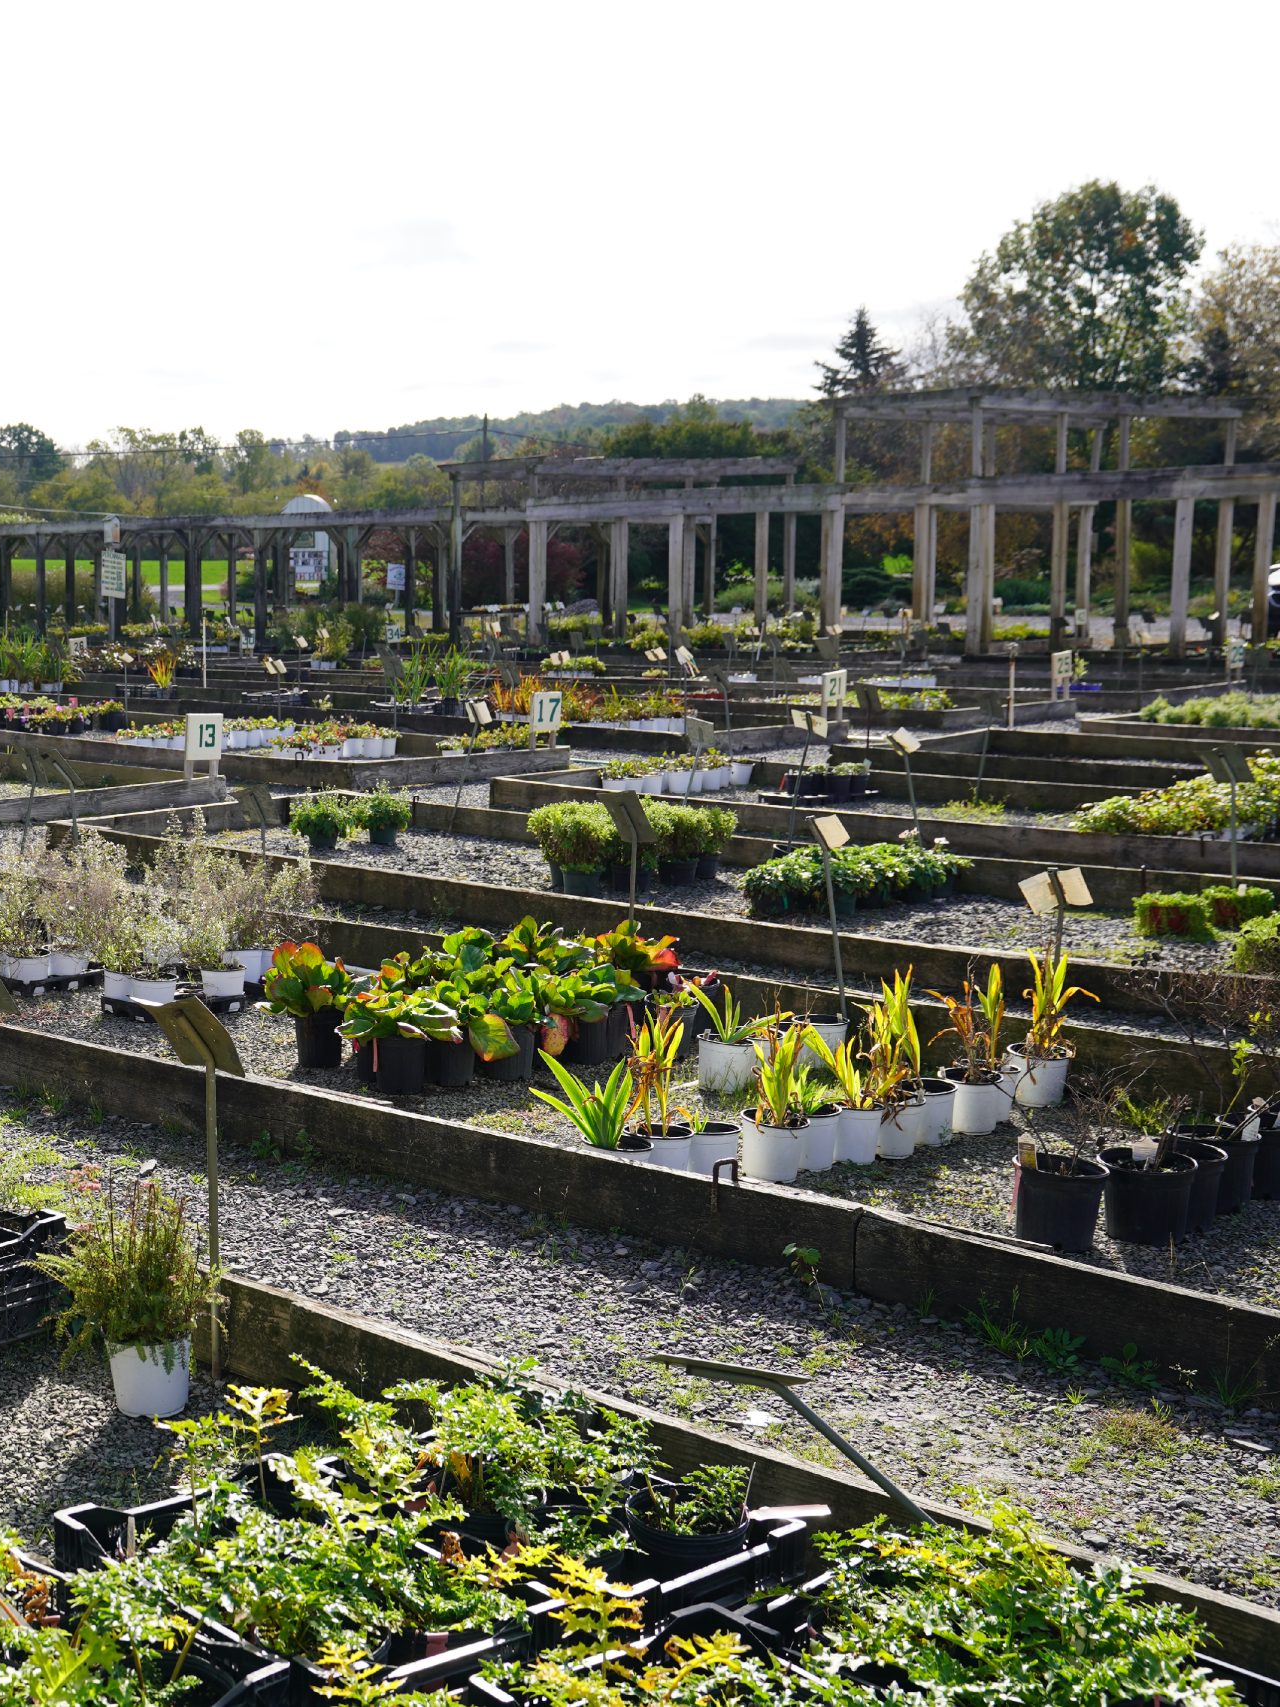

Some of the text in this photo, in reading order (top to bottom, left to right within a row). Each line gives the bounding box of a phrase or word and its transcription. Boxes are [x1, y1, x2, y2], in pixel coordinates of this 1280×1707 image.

[387, 628, 400, 640] 34
[1057, 656, 1070, 674] 25
[829, 676, 841, 696] 21
[538, 698, 560, 722] 17
[199, 723, 215, 748] 13
